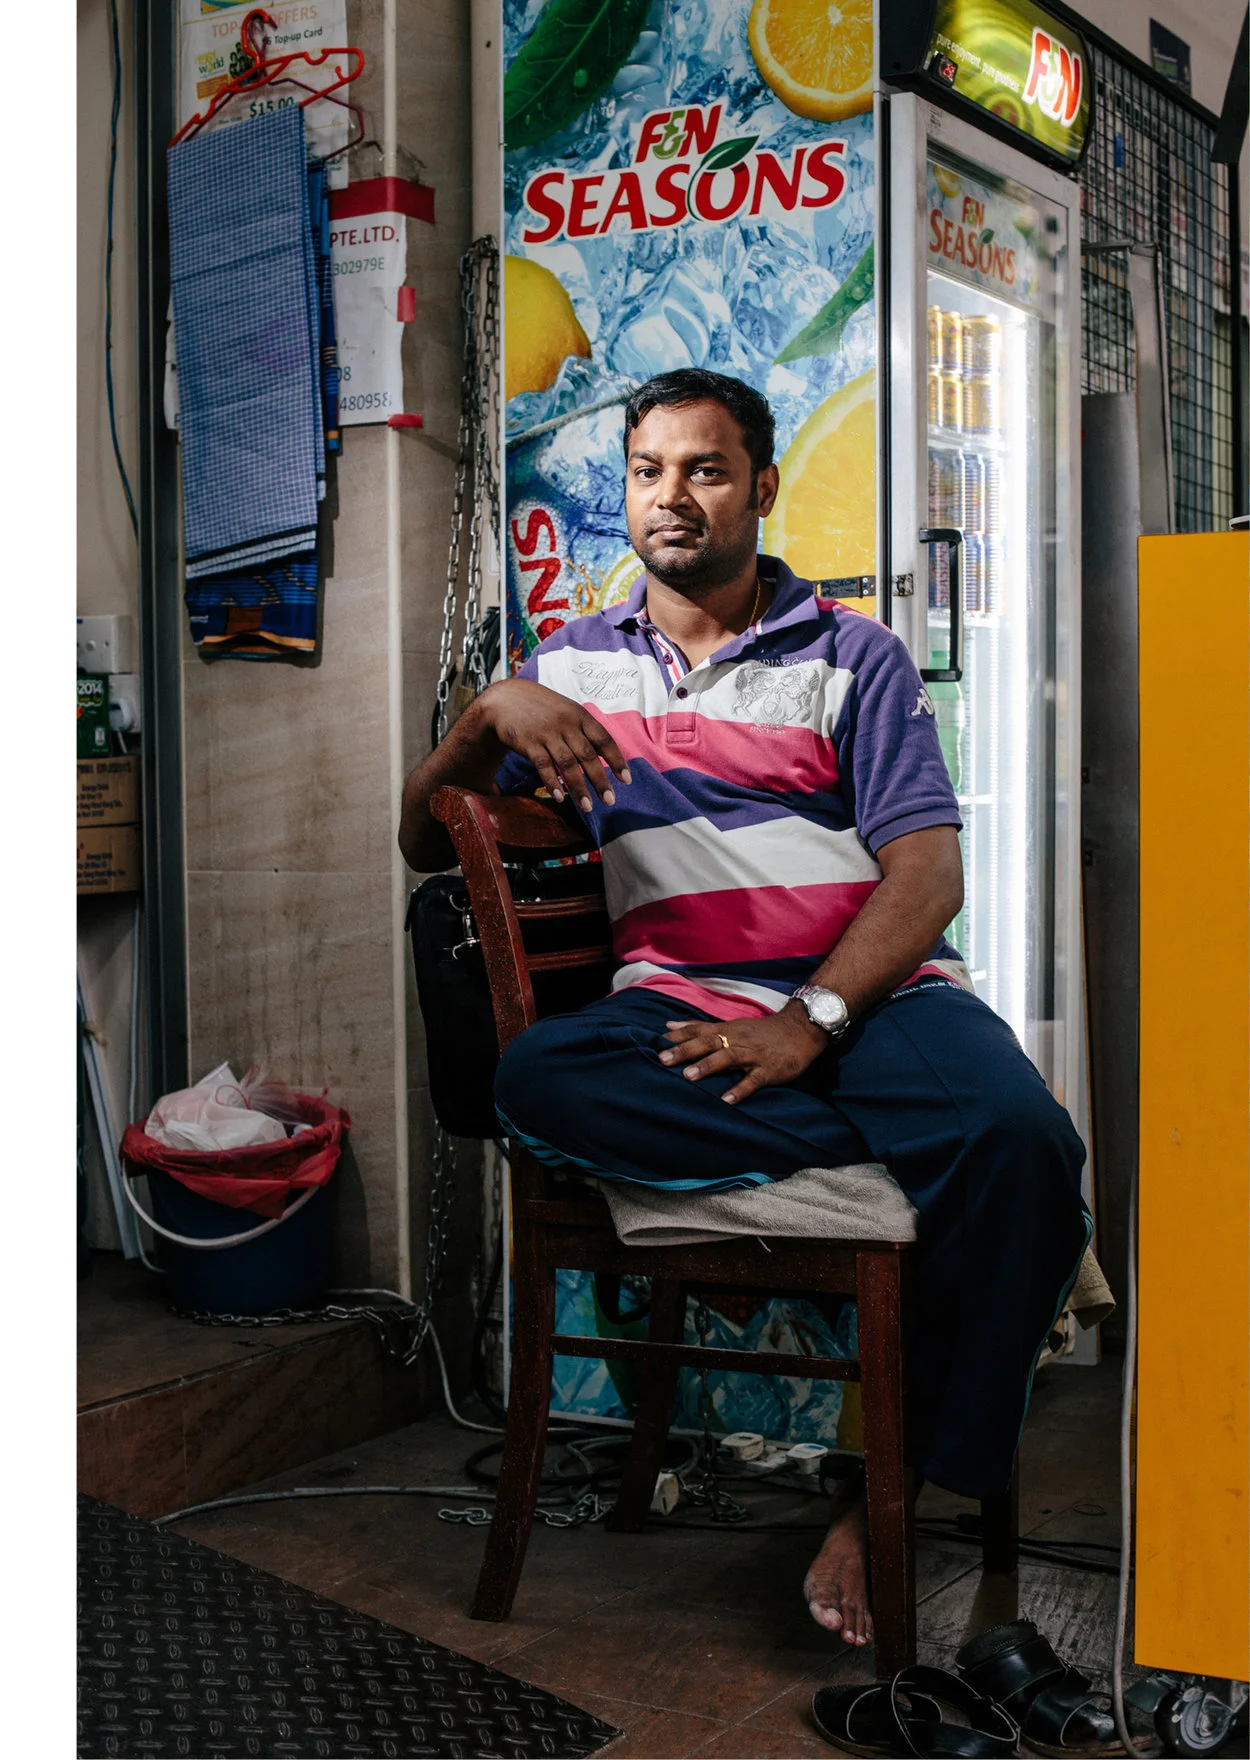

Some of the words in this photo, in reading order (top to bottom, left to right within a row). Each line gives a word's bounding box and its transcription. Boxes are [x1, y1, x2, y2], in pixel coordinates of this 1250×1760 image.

[275, 33, 301, 45] Top-up
[303, 26, 323, 39] Card
[936, 34, 951, 50] pure
[1026, 30, 1081, 122] F&N
[635, 104, 722, 163] F&N
[523, 142, 845, 243] SEASONS
[962, 196, 985, 229] F&N
[330, 225, 400, 248] PTE.LTD.
[928, 208, 1016, 285] SEASONS
[938, 543, 950, 603] SEASONS
